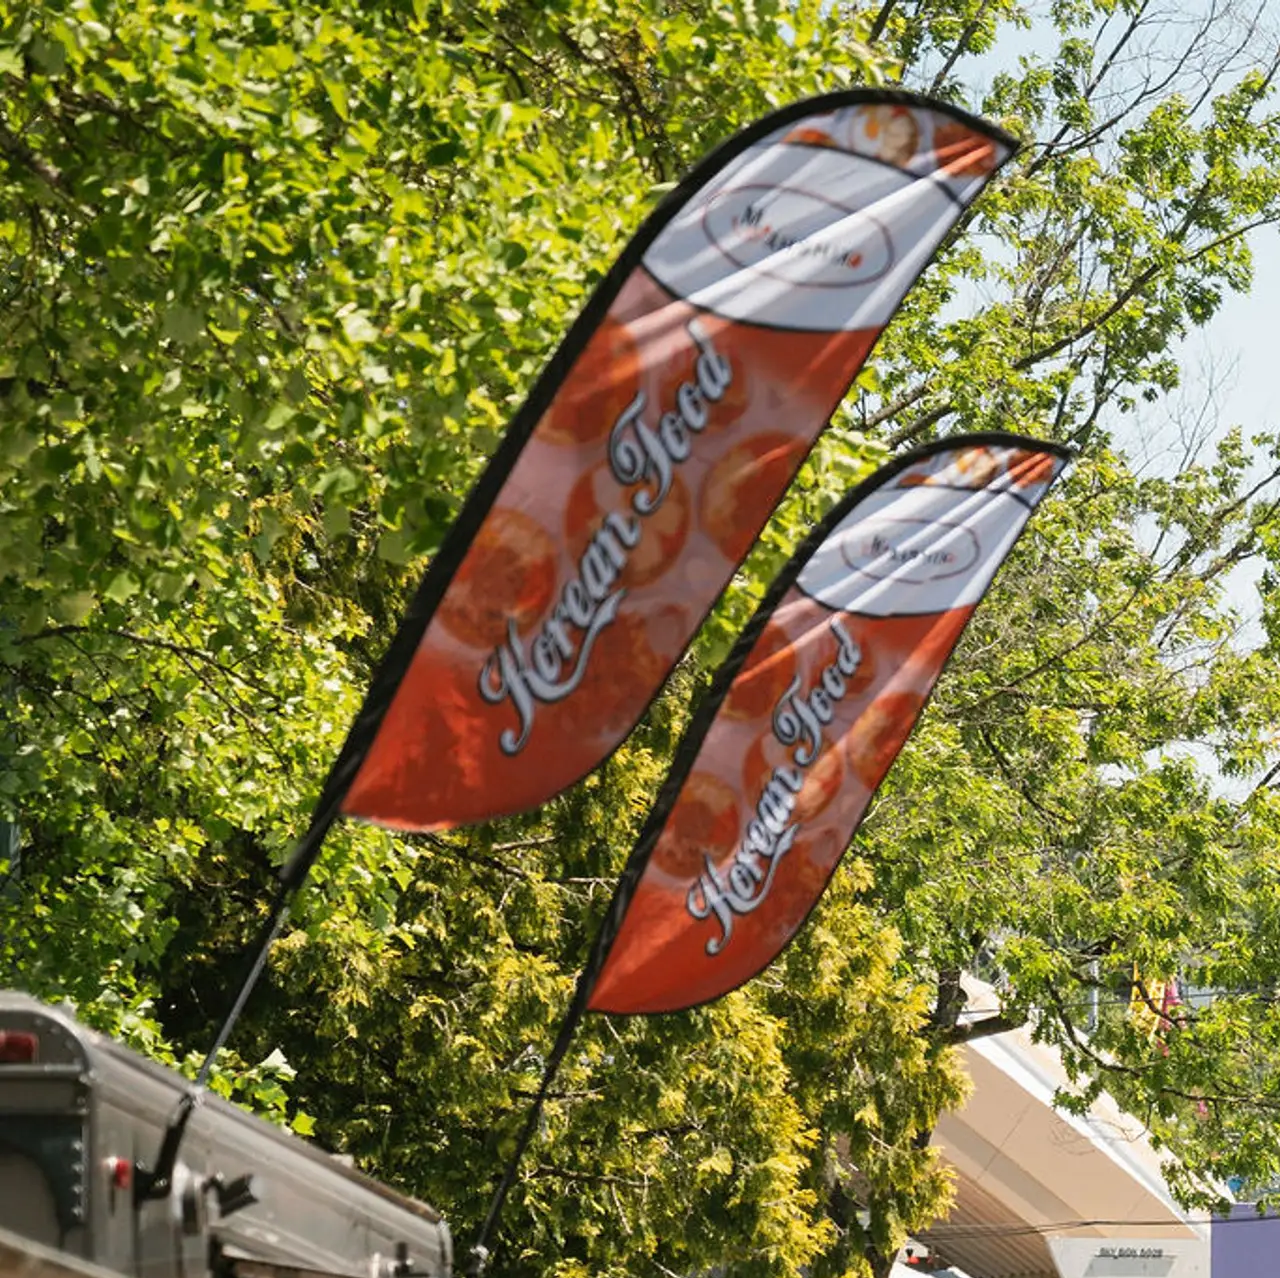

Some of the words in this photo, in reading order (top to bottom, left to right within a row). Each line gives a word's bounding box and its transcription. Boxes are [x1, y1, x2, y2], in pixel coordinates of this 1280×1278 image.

[479, 507, 641, 757] Korean
[609, 317, 732, 516] Food
[687, 765, 803, 956] Korean
[774, 616, 861, 767] Food
